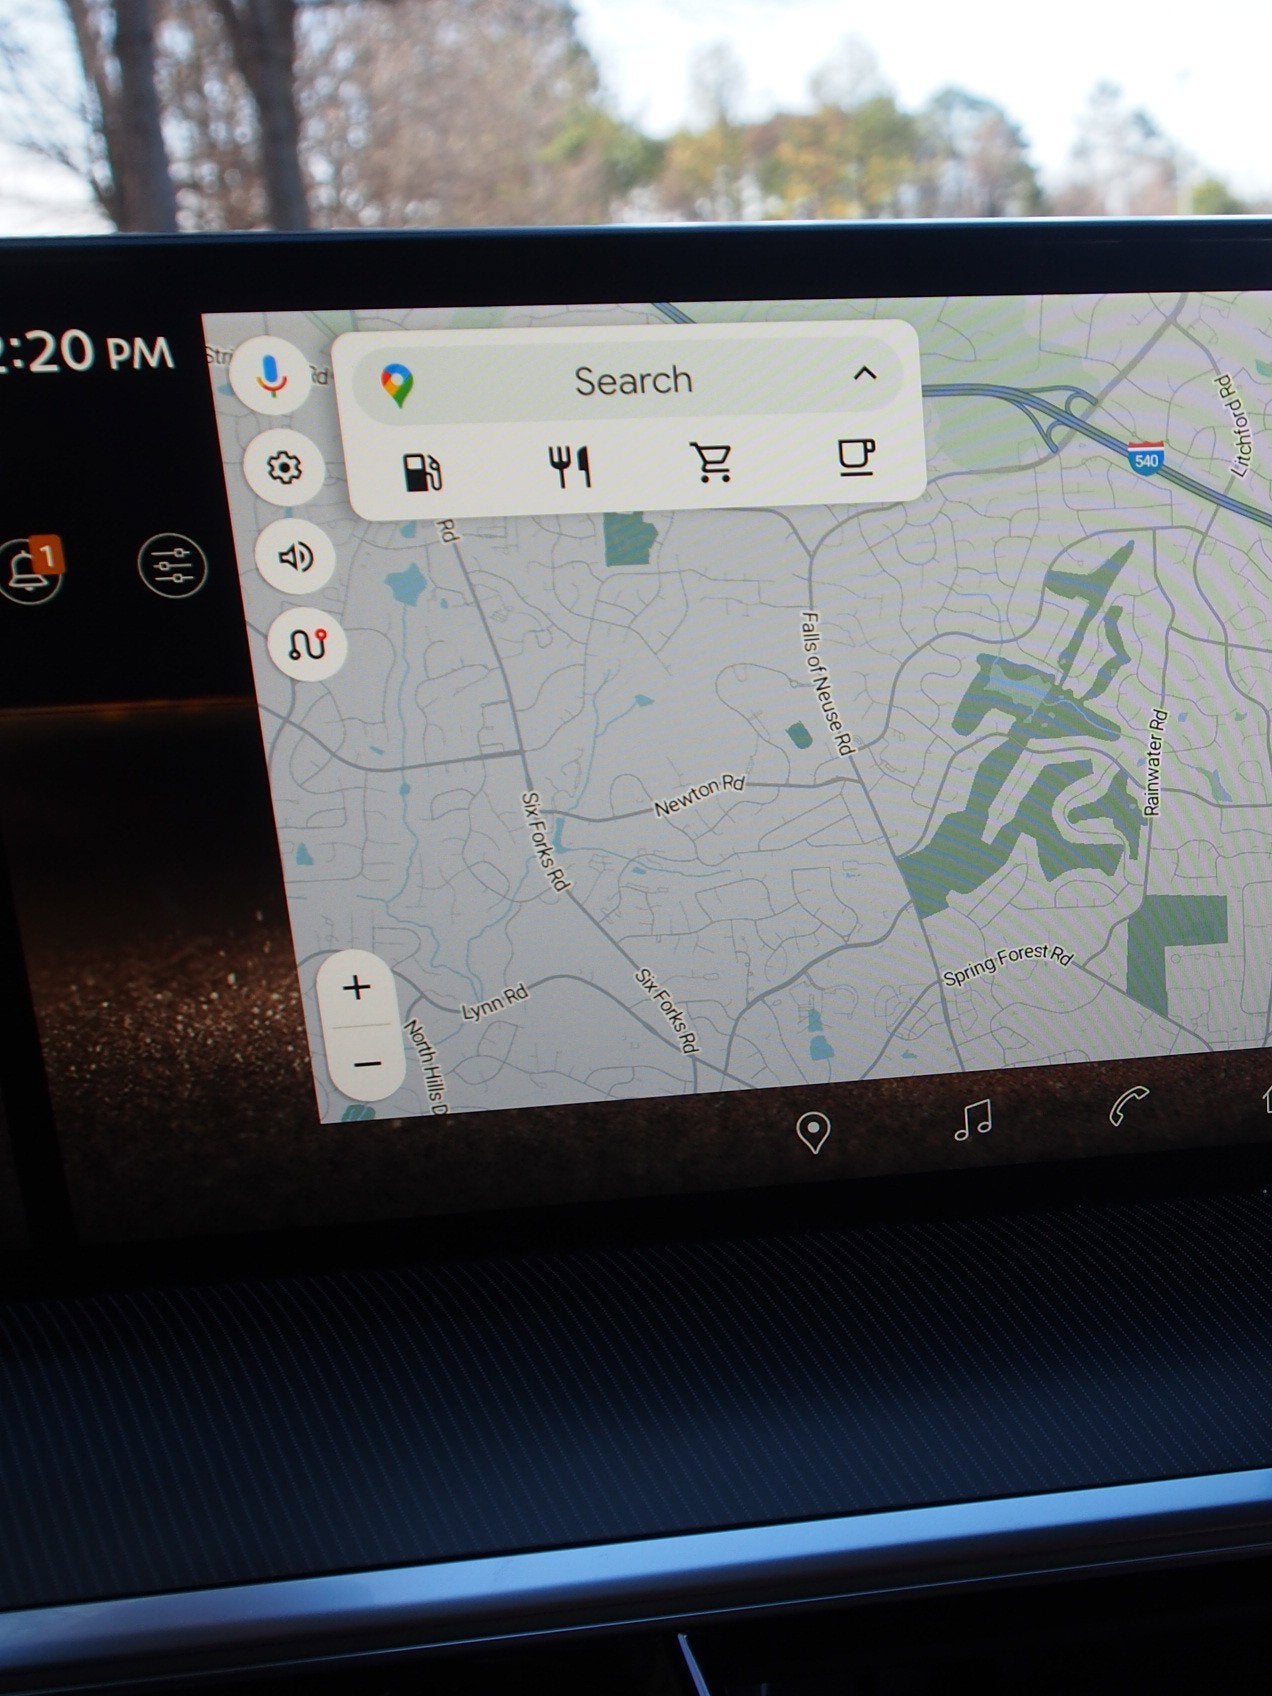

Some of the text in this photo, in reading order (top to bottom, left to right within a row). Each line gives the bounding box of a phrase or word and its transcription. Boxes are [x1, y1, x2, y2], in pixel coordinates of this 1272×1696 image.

[0, 328, 176, 373] :20 PM
[575, 364, 693, 396] Search
[1214, 374, 1252, 478] Litchford Rd
[1134, 453, 1160, 468] 540
[436, 518, 462, 543] Rd
[39, 545, 55, 567] 1
[802, 612, 857, 757] Falls of Neuse Rd
[1143, 708, 1169, 816] Rainwater Rd
[654, 774, 746, 818] Newton Rd
[522, 792, 571, 893] Six Forks Rd
[943, 944, 1075, 987] Spring Forest Rd
[462, 983, 529, 1022] Lynn Rd
[635, 967, 700, 1056] Six Forks Rd
[404, 1019, 437, 1065] North
[424, 1066, 446, 1102] Hills
